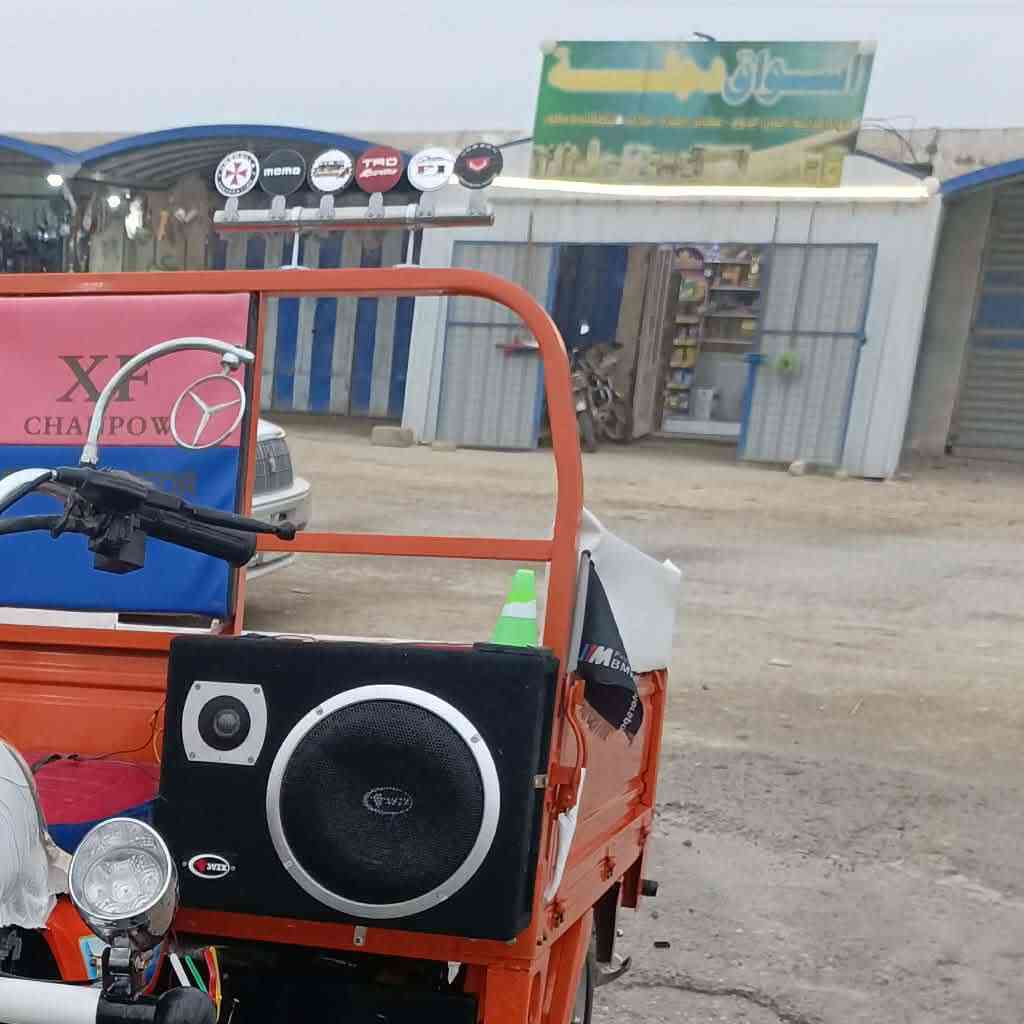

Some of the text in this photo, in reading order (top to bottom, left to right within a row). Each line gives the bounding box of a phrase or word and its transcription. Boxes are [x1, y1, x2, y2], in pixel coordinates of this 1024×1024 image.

[362, 157, 398, 169] TRD
[56, 355, 152, 402] XF
[24, 416, 173, 436] CHAPOW
